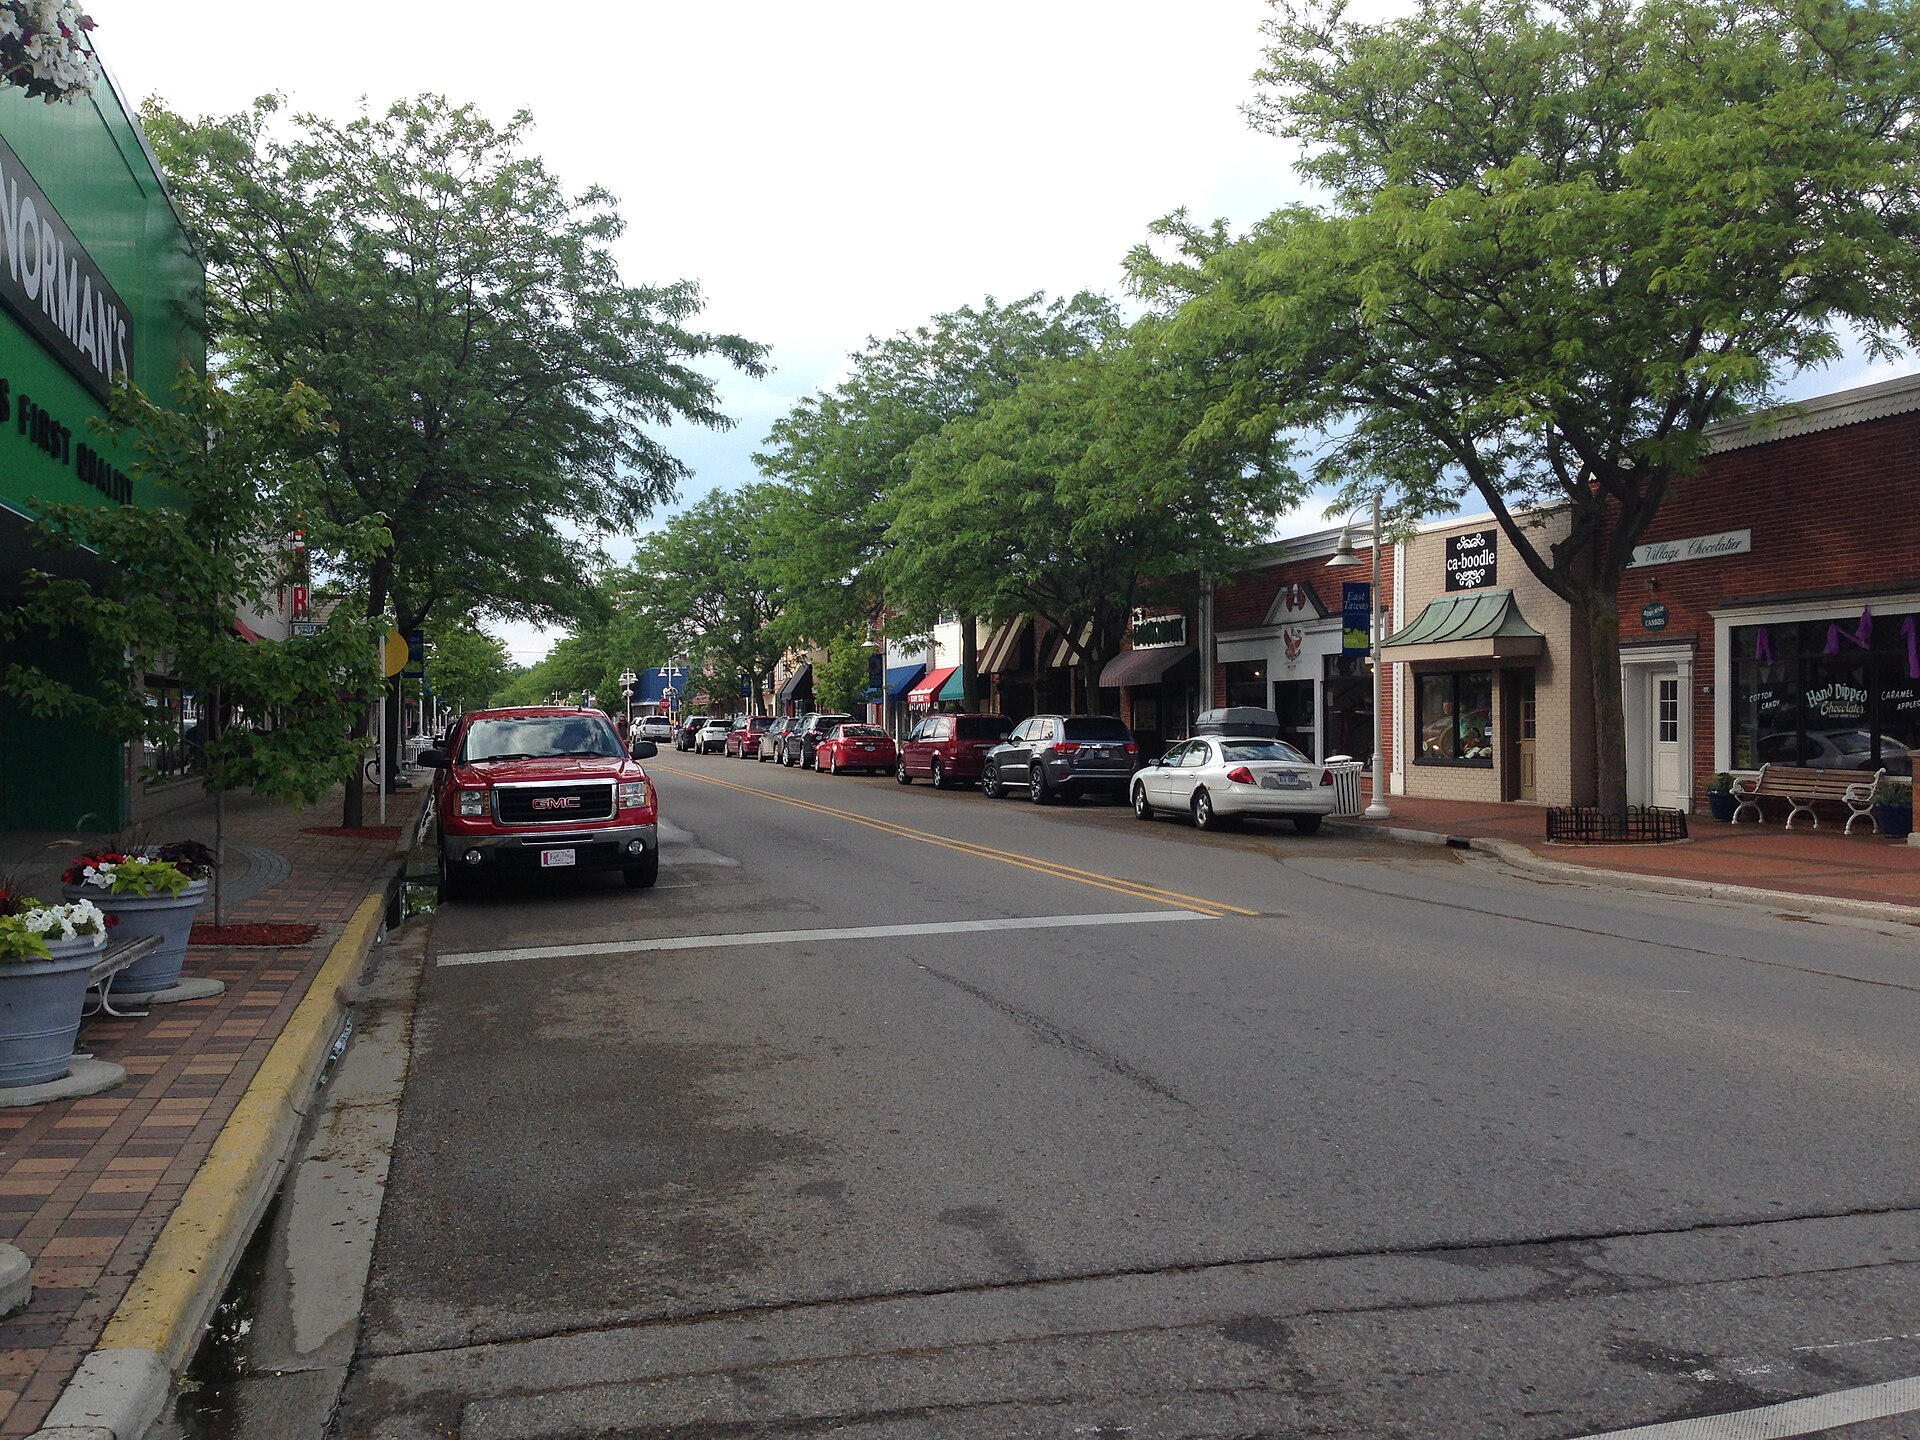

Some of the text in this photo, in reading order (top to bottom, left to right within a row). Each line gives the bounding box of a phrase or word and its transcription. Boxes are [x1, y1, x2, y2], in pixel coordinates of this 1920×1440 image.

[0, 160, 128, 390] NORMAN'S
[18, 394, 71, 465] FIRST
[1644, 536, 1742, 561] Village Chocolatier
[1447, 549, 1495, 571] ca-boodle
[1346, 591, 1366, 601] East
[1343, 601, 1369, 611] Tawas
[1749, 691, 1774, 703] COTTON
[1805, 683, 1833, 709] Hand
[1880, 689, 1914, 701] CARAMEL
[1761, 699, 1781, 710] CANDY
[1896, 700, 1920, 711] APPLES
[532, 796, 581, 810] GMC
